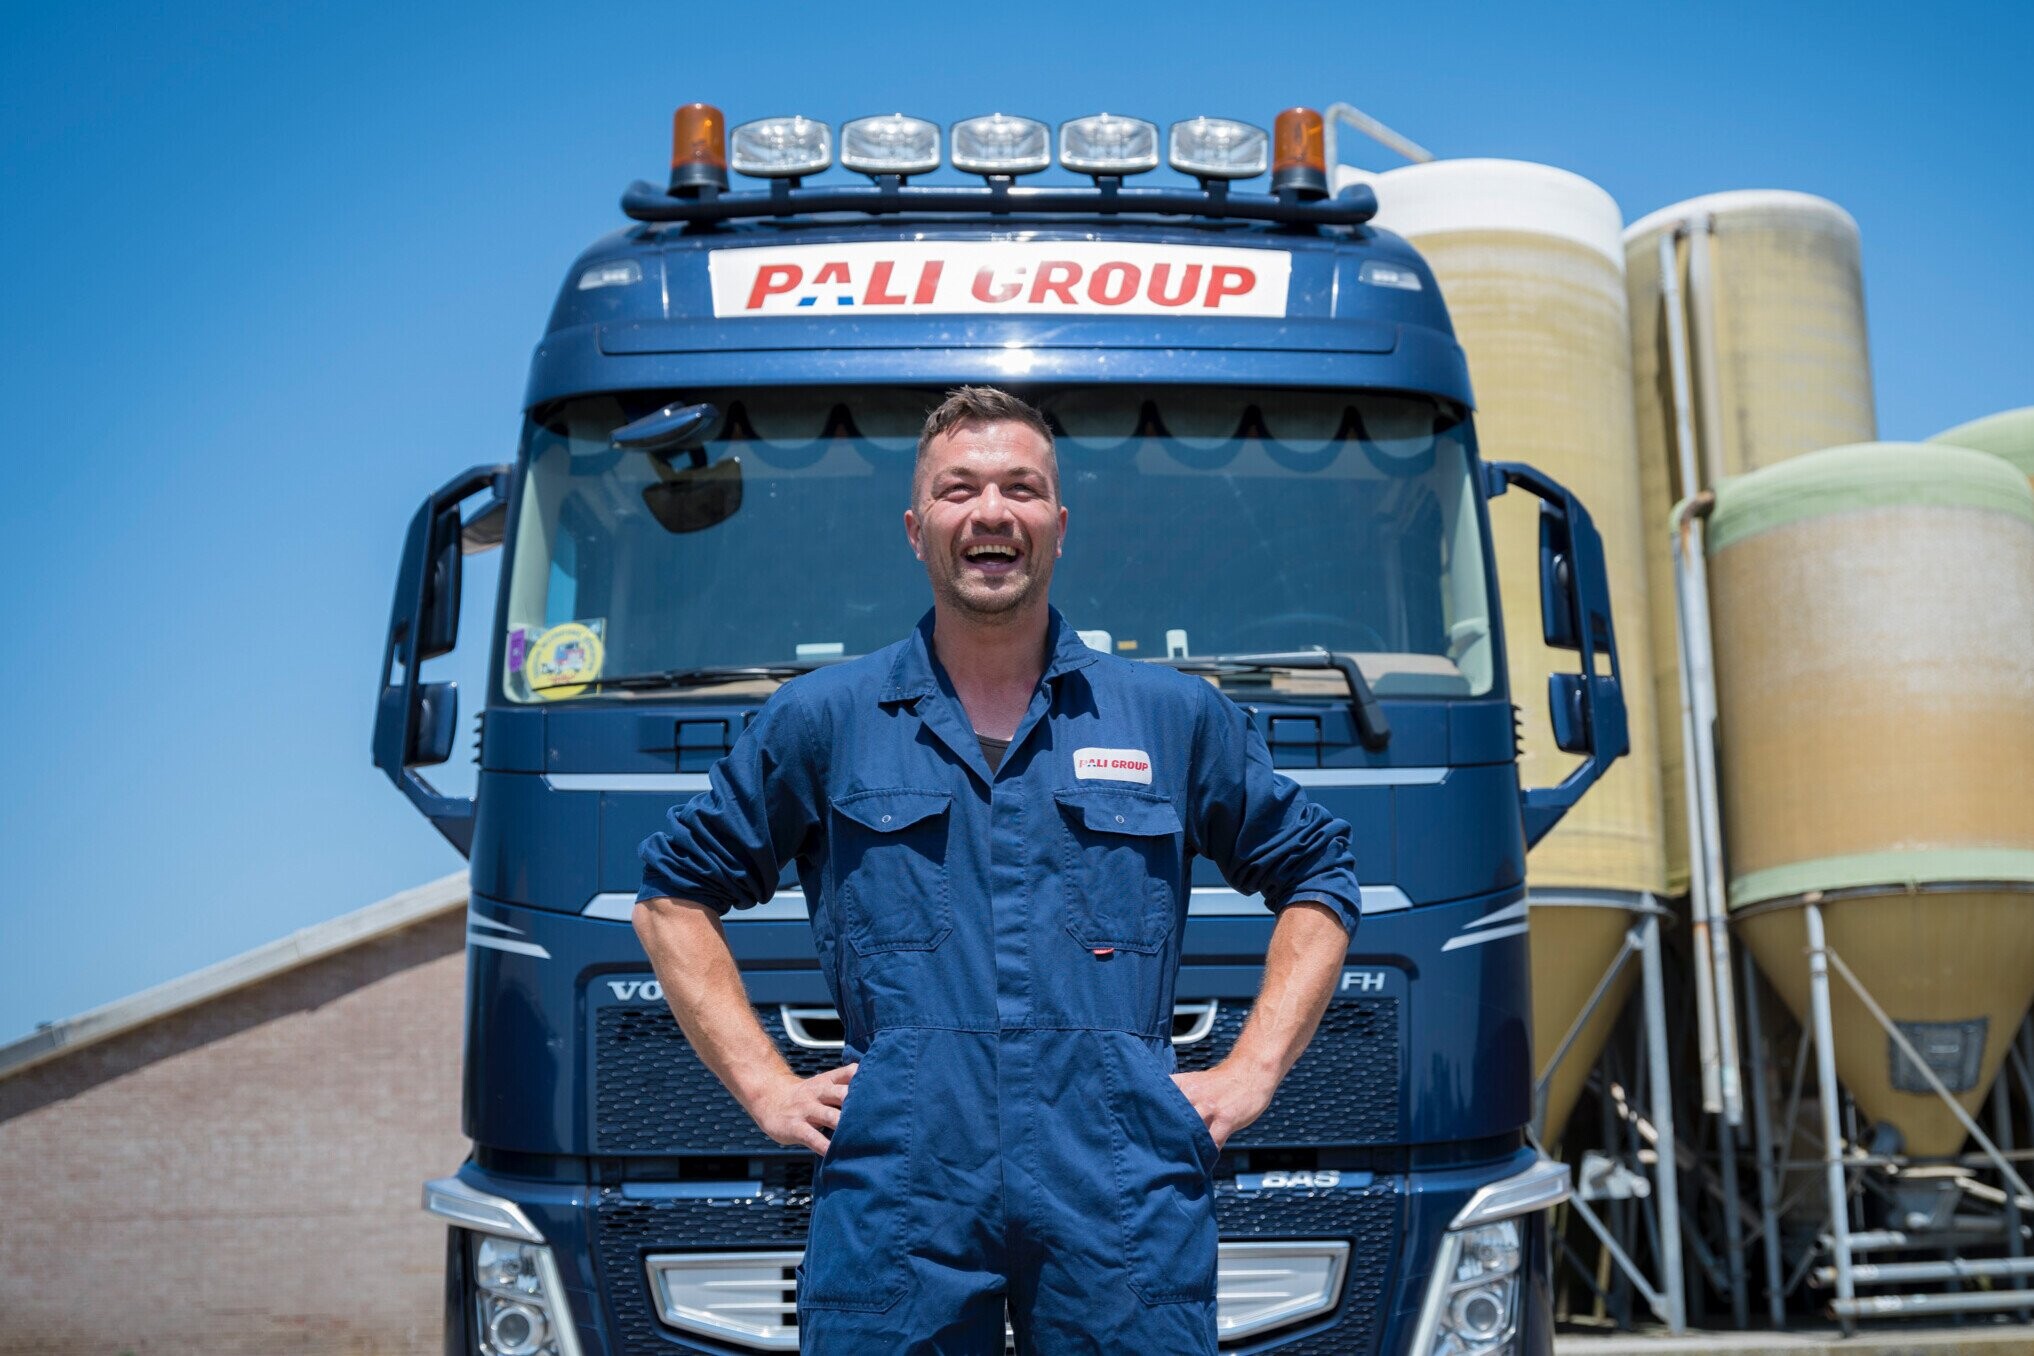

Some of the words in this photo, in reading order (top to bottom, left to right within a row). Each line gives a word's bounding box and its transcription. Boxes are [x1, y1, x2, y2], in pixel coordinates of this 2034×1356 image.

[746, 260, 945, 309] PALI
[971, 260, 1256, 308] GROUP
[1079, 758, 1108, 768] PALI
[1111, 759, 1148, 771] GROUP
[606, 980, 666, 1001] VO
[1341, 971, 1385, 991] FH
